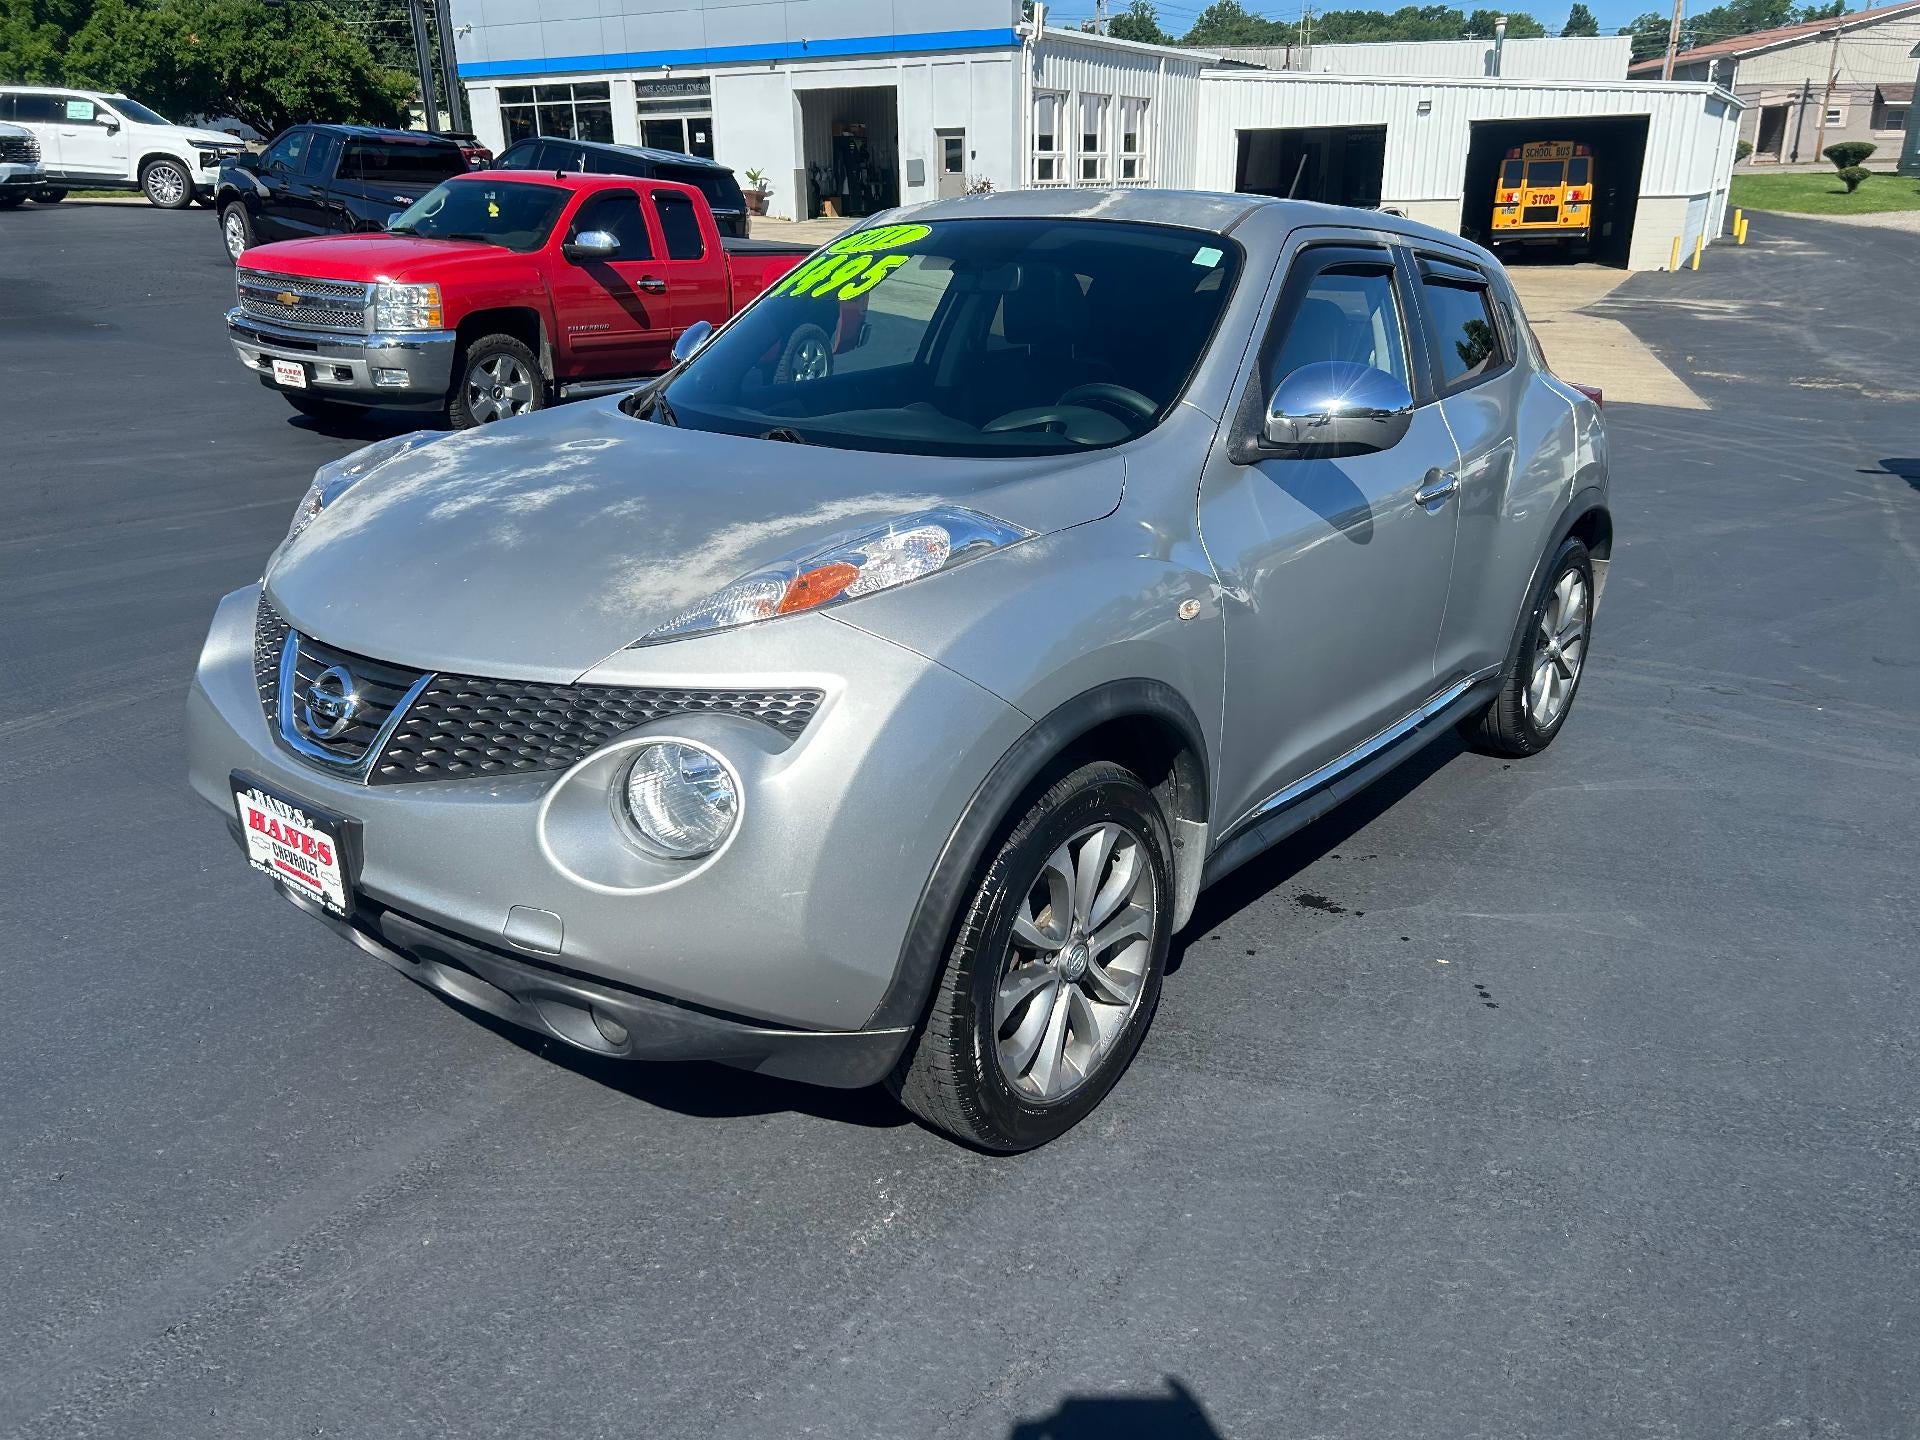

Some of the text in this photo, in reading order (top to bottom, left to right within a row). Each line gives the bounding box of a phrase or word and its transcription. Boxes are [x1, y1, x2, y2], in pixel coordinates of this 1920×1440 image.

[1526, 146, 1570, 158] SCHOOL BUS
[1531, 194, 1556, 206] STOP
[248, 807, 333, 866] HANES
[250, 859, 281, 881] SOUTH
[272, 841, 319, 879] CHEVROLET
